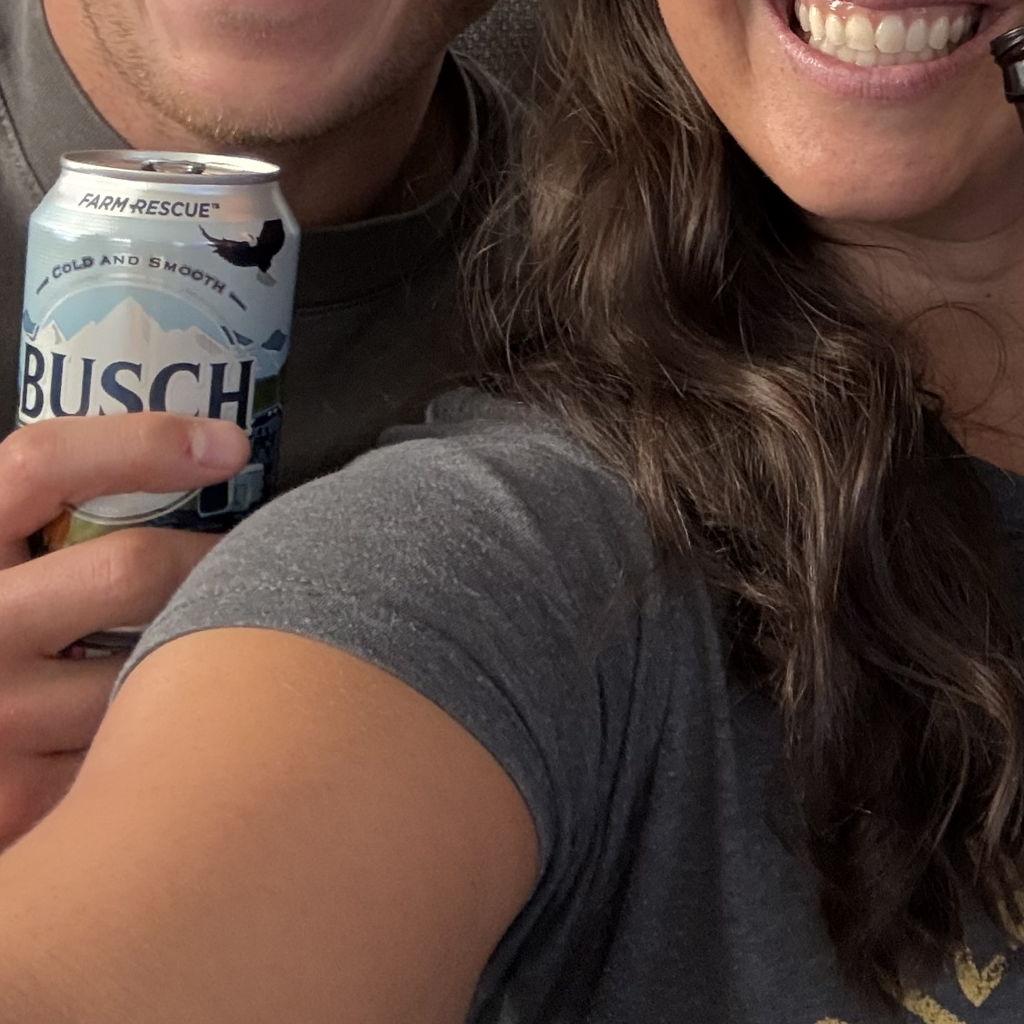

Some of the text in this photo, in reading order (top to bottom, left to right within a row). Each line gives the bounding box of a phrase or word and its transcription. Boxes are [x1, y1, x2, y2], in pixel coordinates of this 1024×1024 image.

[78, 192, 130, 213] FARM
[52, 255, 227, 294] COLD AND SMOOTH
[21, 342, 254, 429] BUSCH
